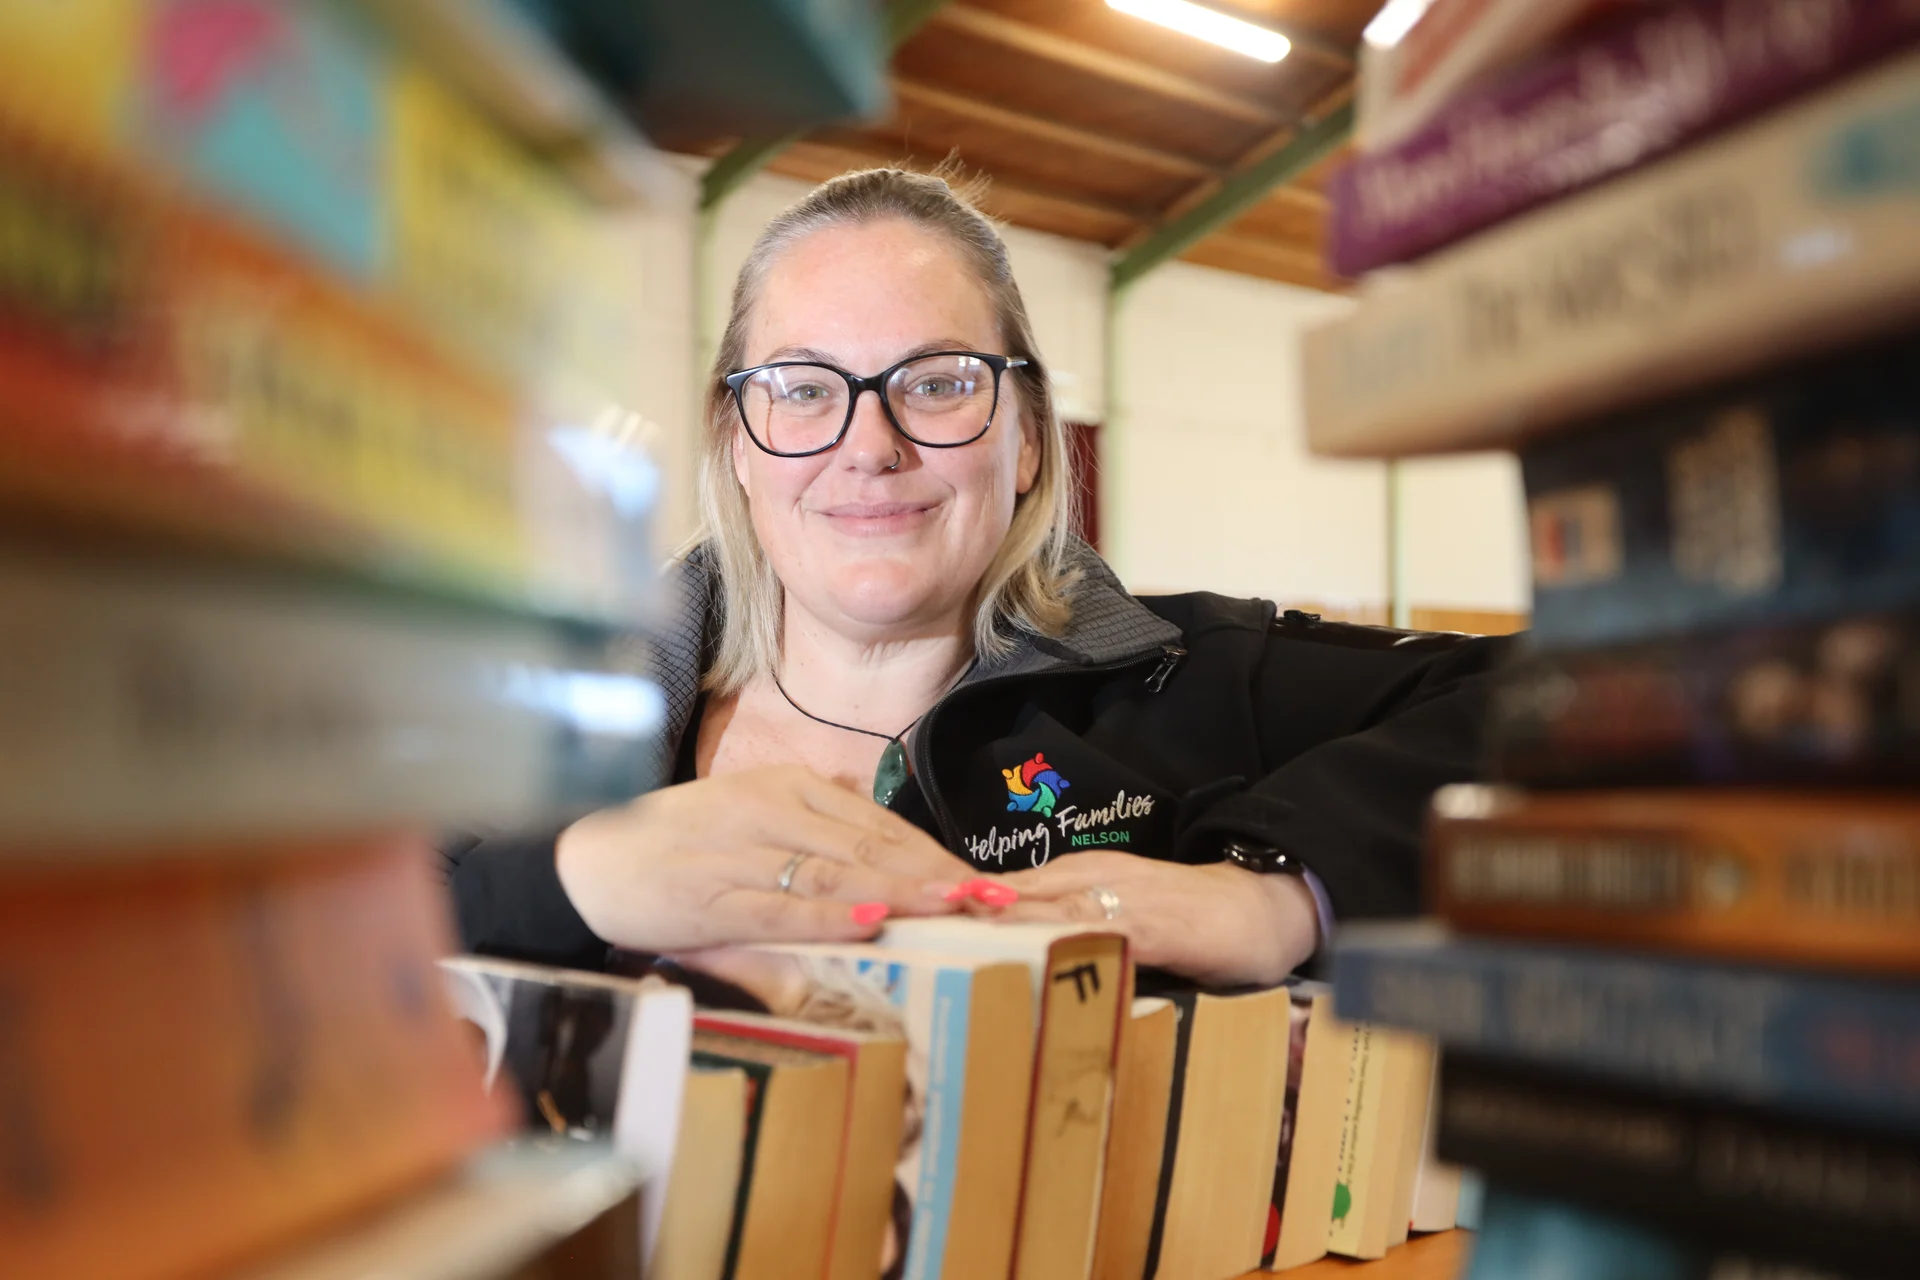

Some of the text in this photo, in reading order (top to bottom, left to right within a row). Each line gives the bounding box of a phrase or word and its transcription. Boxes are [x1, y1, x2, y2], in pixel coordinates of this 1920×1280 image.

[965, 790, 1155, 869] Helping Families
[1071, 831, 1131, 846] NELSON
[1053, 960, 1101, 1004] F
